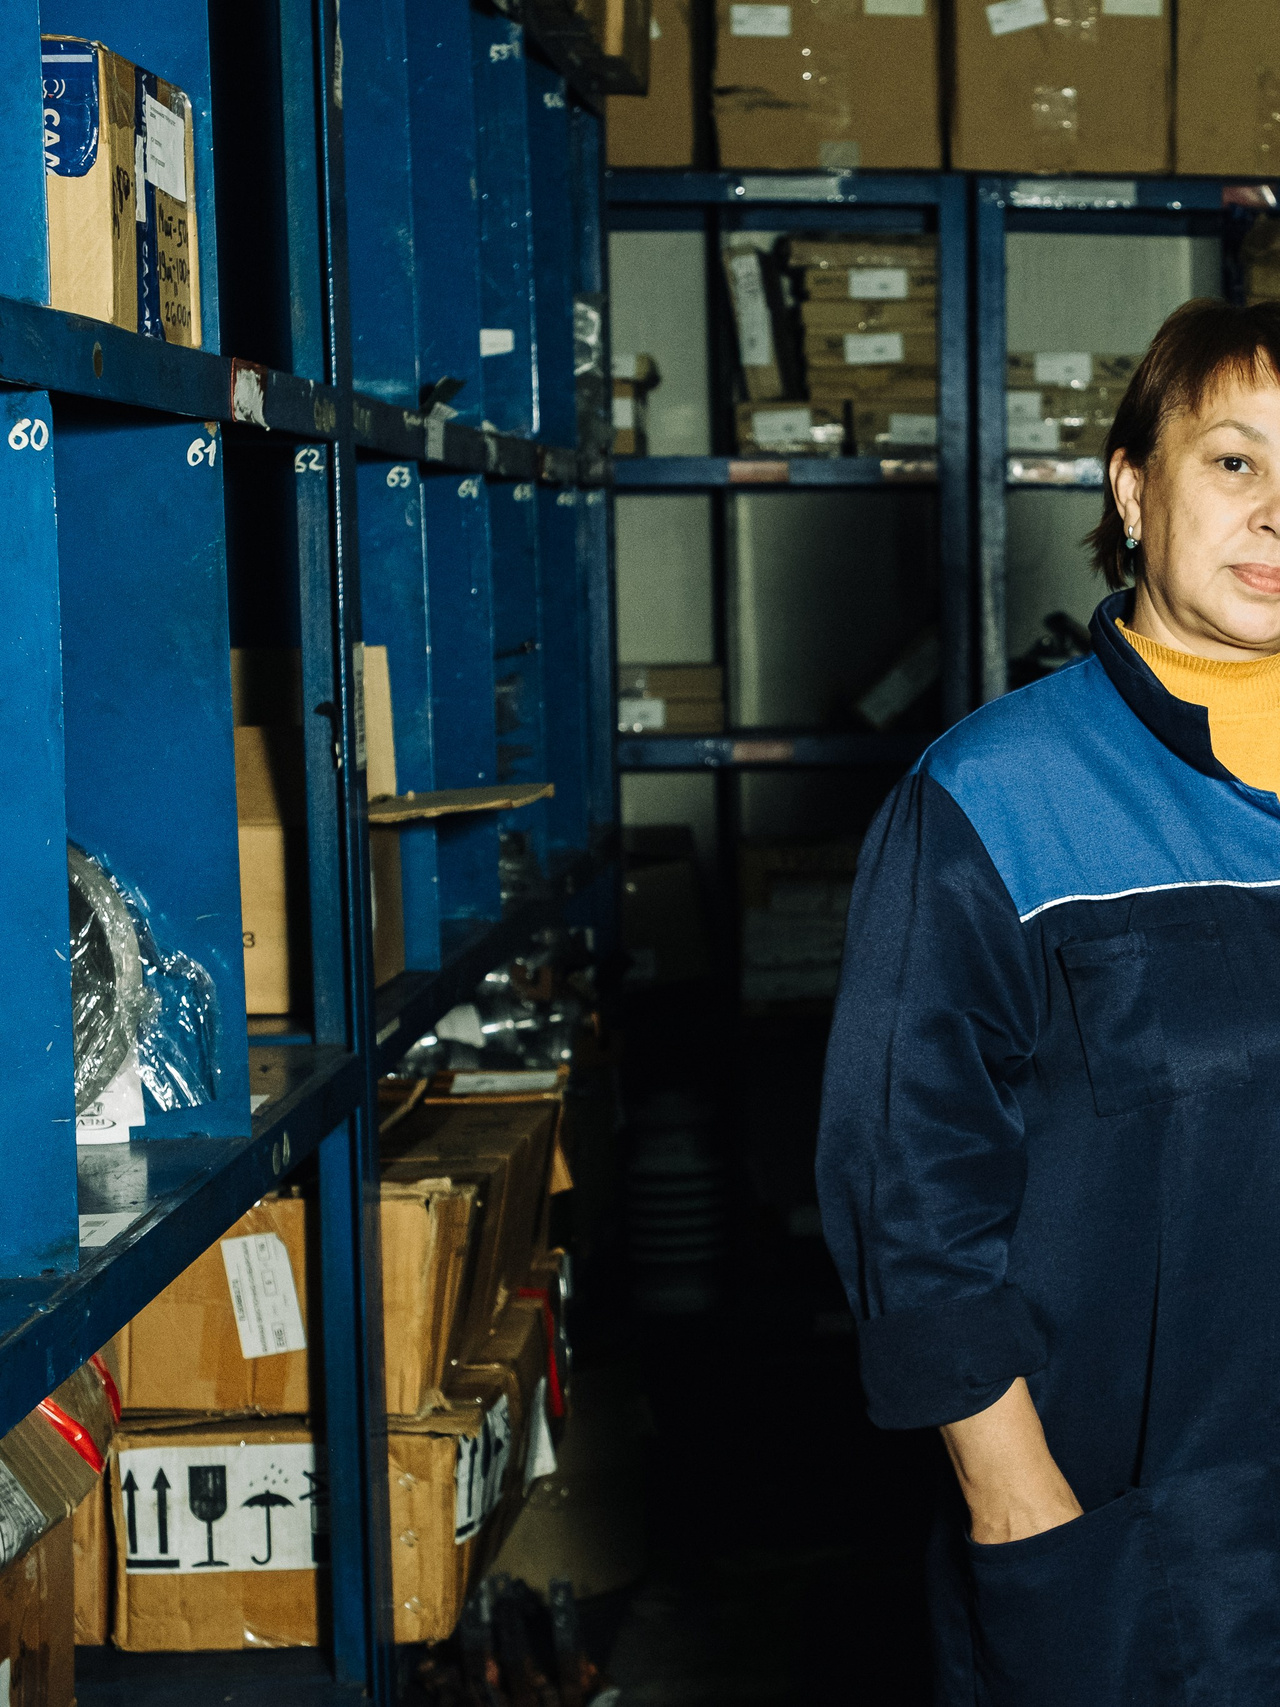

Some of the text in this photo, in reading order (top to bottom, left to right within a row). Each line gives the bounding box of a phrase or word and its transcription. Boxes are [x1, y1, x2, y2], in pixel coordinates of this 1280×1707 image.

[7, 418, 49, 451] 60
[186, 438, 217, 467] 61
[294, 448, 325, 473] 62
[386, 465, 412, 489] 63
